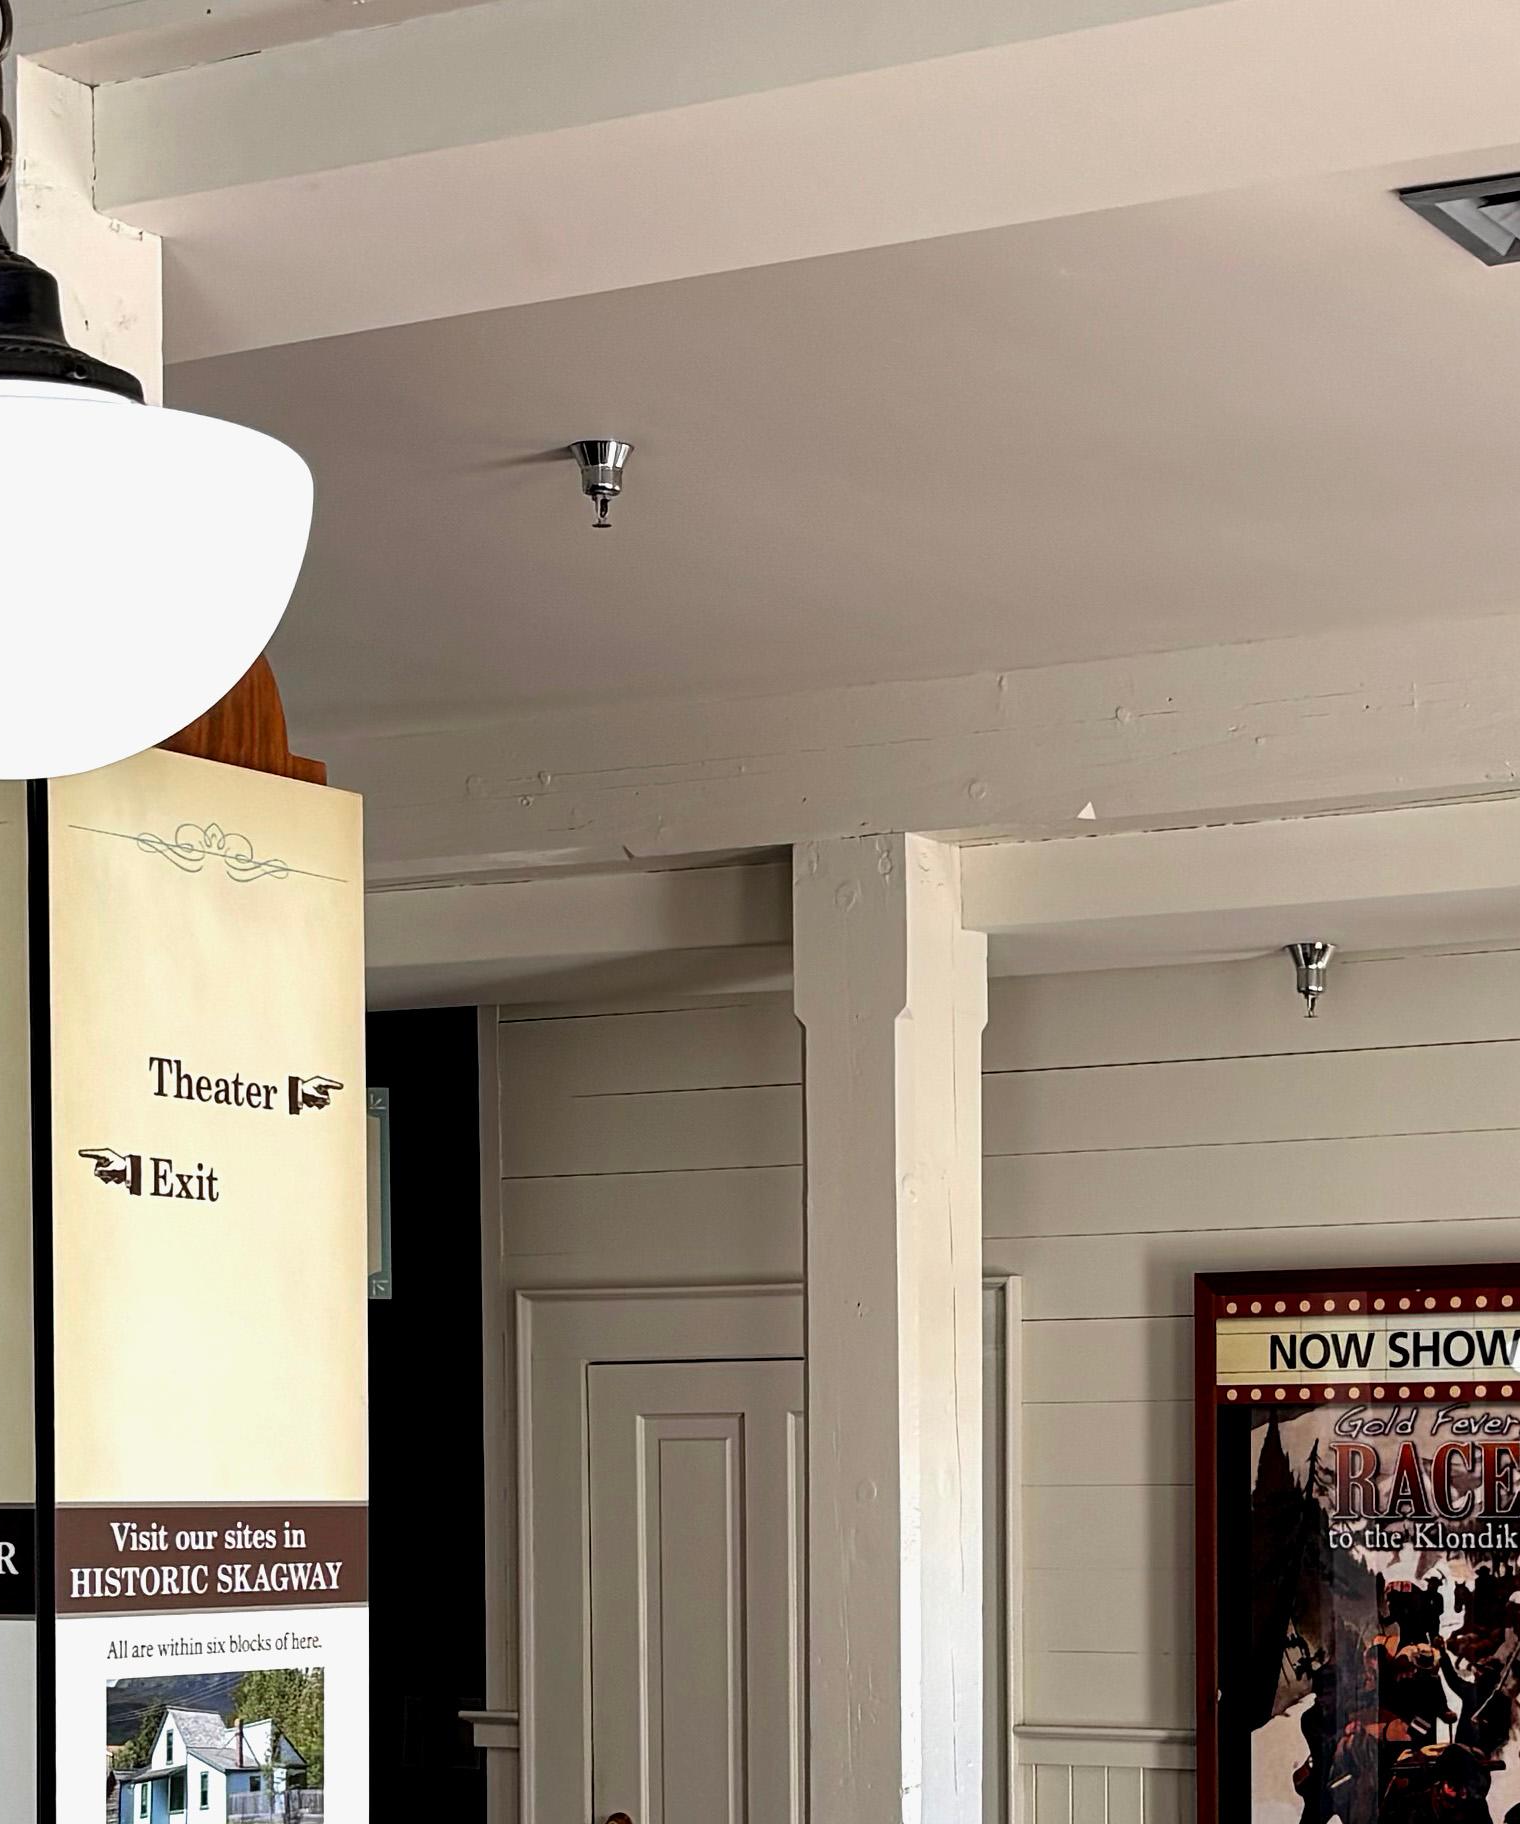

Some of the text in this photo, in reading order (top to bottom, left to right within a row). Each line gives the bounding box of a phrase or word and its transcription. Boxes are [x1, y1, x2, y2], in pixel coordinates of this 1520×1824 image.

[149, 1056, 278, 1110] Theater
[149, 1157, 220, 1202] Exit
[1269, 1333, 1374, 1370] NOW
[1334, 1404, 1418, 1440] Gold
[110, 1521, 306, 1552] Visit our sites in
[1328, 1528, 1353, 1549] to
[1364, 1523, 1402, 1549] the
[70, 1561, 343, 1598] HISTORIC SKAGWAY
[106, 1632, 322, 1660] All are within six blocks of here.
